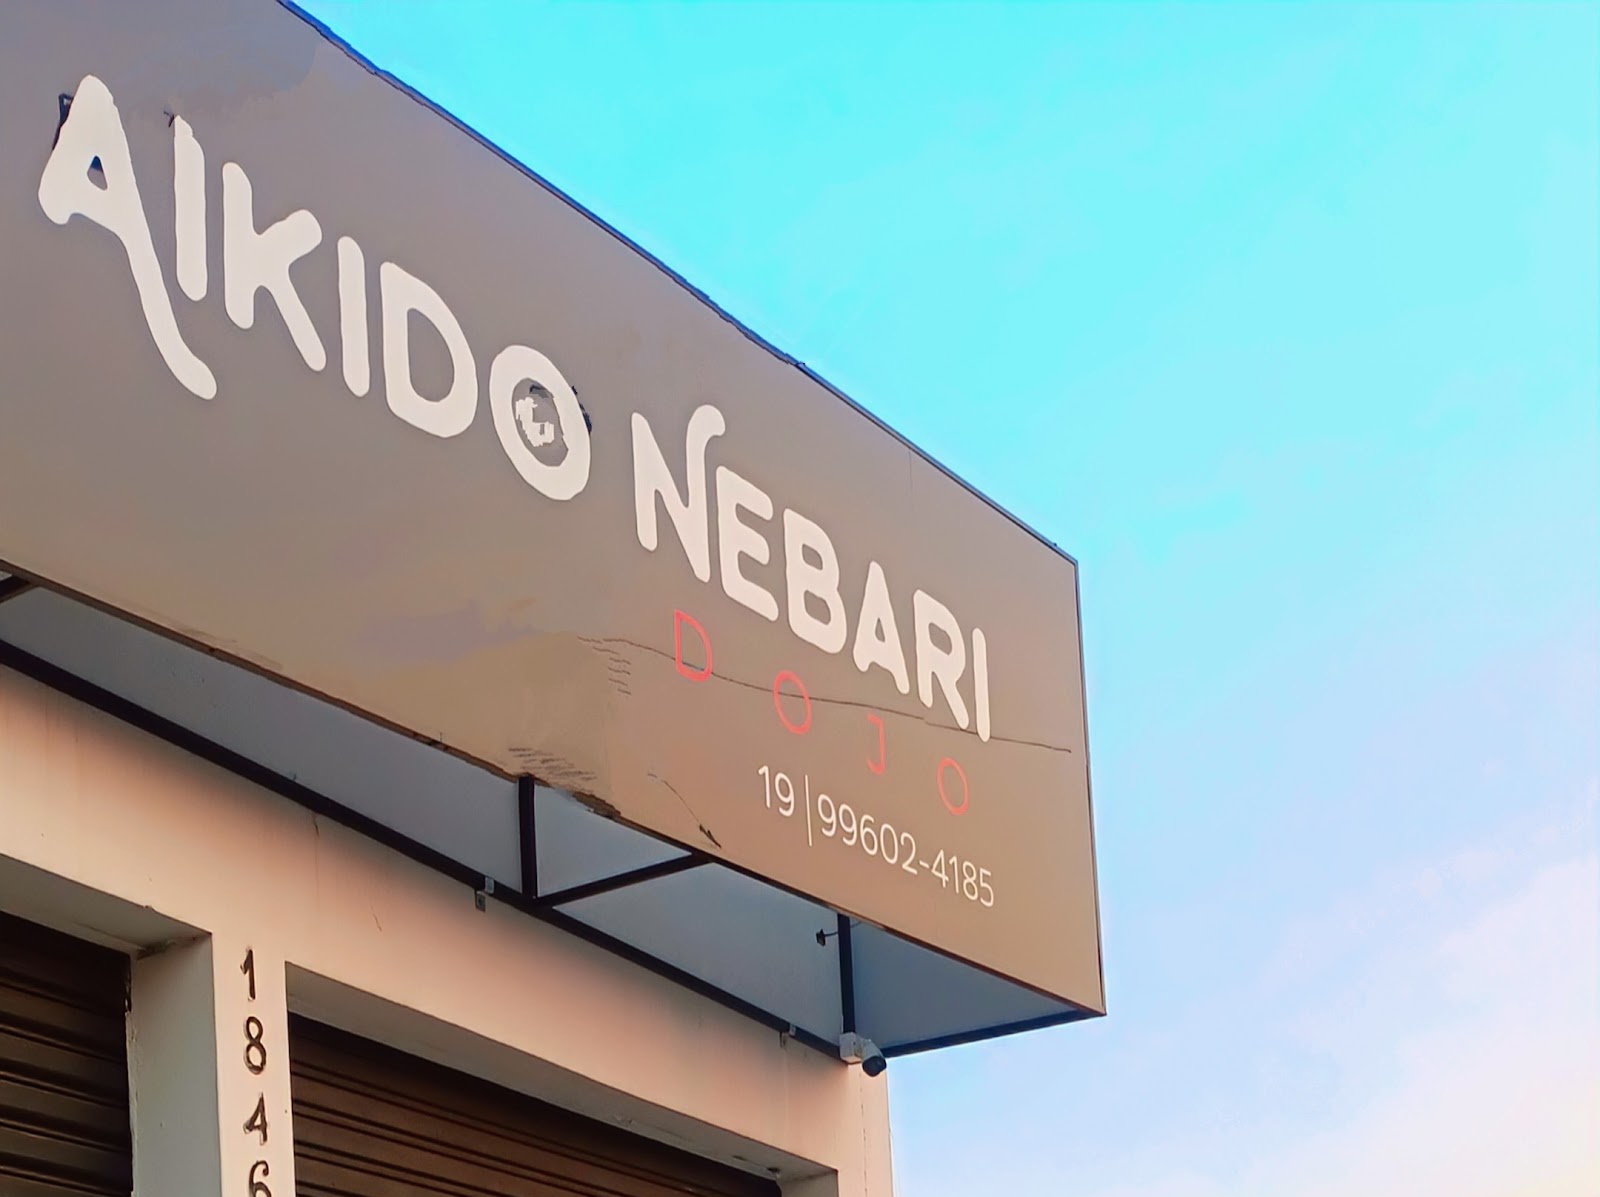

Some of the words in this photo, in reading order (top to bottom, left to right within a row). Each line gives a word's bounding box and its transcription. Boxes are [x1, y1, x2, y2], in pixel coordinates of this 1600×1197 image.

[38, 74, 592, 501] AIKIDO
[631, 404, 991, 742] NEBARI
[674, 610, 969, 816] DOJO
